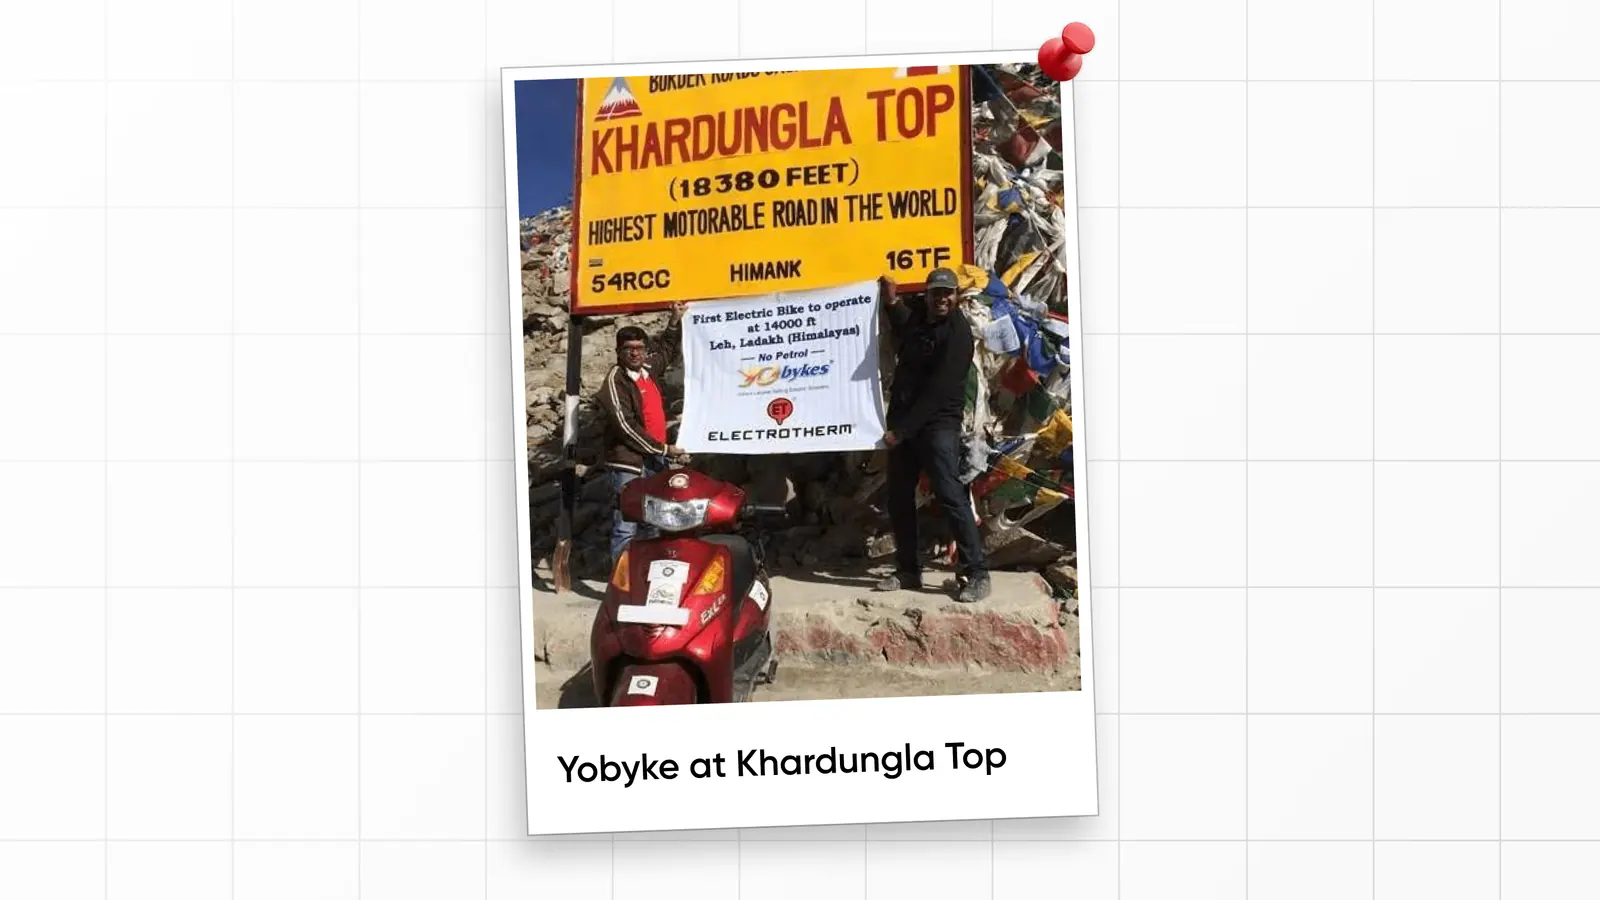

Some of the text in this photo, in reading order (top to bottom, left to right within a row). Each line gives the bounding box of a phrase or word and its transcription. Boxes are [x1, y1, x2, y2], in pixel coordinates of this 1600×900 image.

[591, 84, 955, 176] KHARDUNGLA TOP
[669, 158, 859, 202] (18380 FEET)
[588, 187, 957, 245] HIGHEST MOTORABLE ROAD IN THE WORLD
[592, 269, 670, 293] 54RCC
[730, 260, 801, 282] HIMANK
[693, 295, 872, 325] First Electric Bike to operate
[709, 324, 860, 351] Leh, Ladakh (Himalayas)
[747, 316, 817, 333] at 14000 ft
[758, 349, 808, 362] No Petrol
[771, 402, 789, 415] ET
[708, 424, 852, 442] ELECTROTHERM
